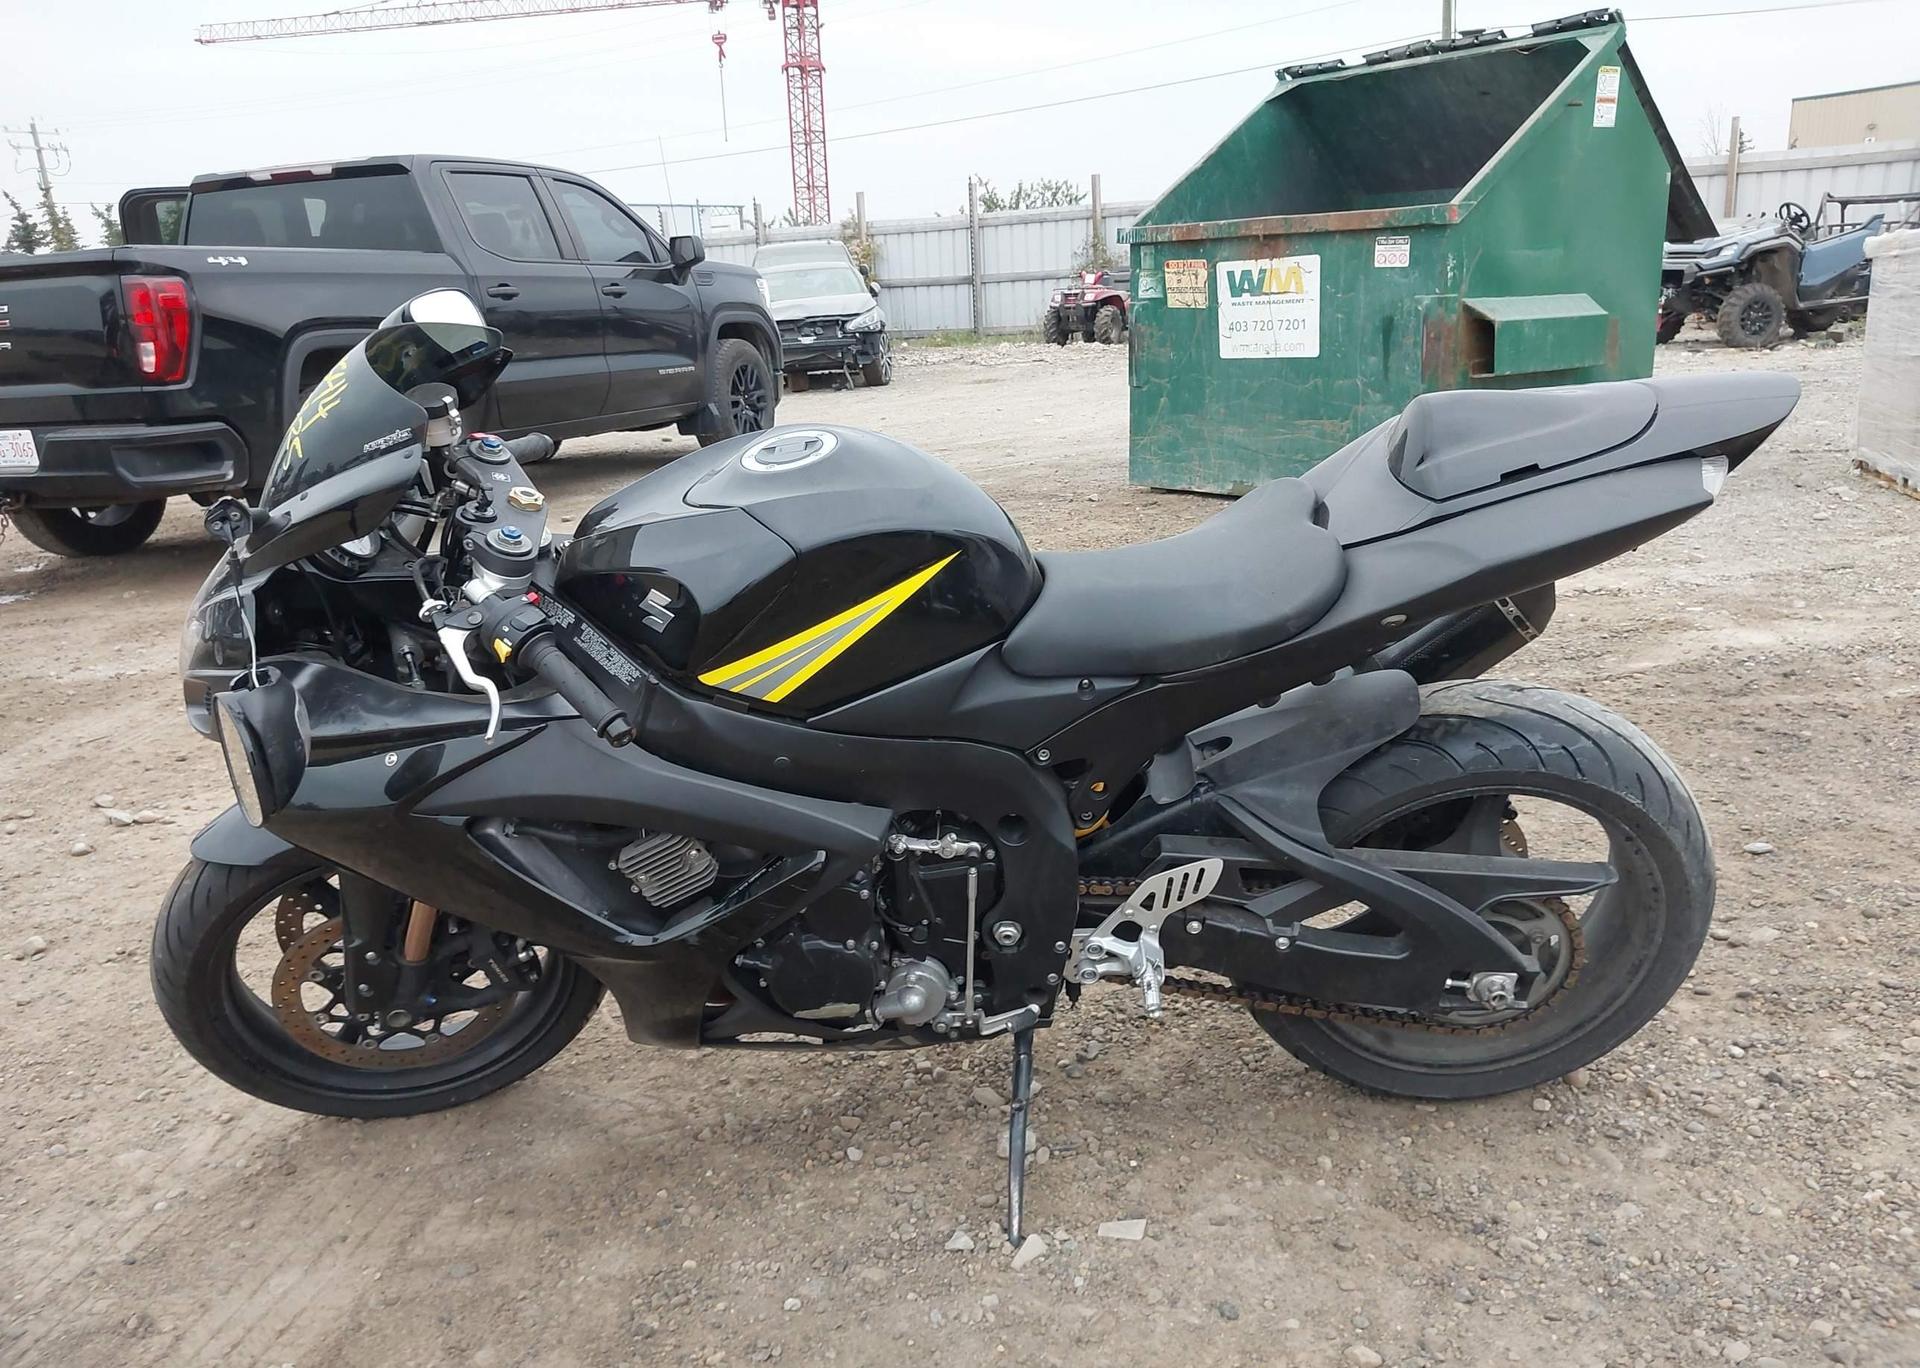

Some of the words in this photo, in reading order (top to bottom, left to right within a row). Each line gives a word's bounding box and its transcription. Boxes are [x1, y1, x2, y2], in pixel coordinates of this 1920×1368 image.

[1226, 266, 1305, 298] WM
[1255, 298, 1305, 306] MANAGEMENT
[1228, 320, 1249, 333] 403
[1251, 319, 1274, 332] 720
[1277, 318, 1306, 331] 7201
